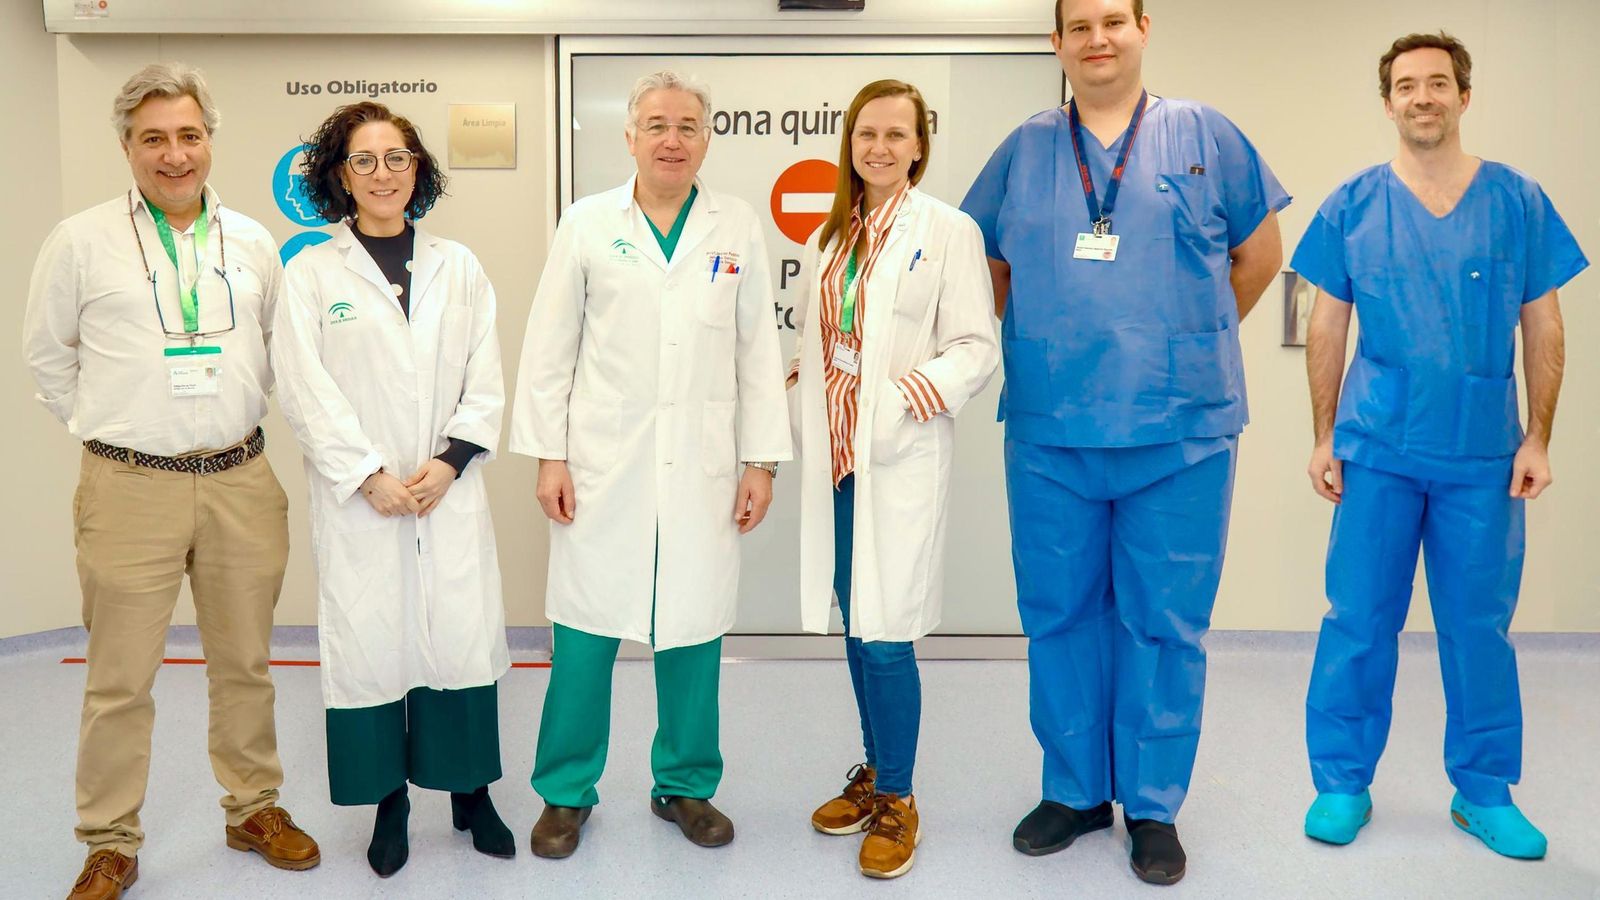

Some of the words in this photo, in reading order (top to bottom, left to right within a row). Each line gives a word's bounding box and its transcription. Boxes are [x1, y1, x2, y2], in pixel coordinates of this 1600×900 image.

[286, 81, 322, 95] Uso
[327, 79, 438, 98] Obligatorio
[481, 118, 506, 129] Limpia
[712, 110, 771, 135] ona
